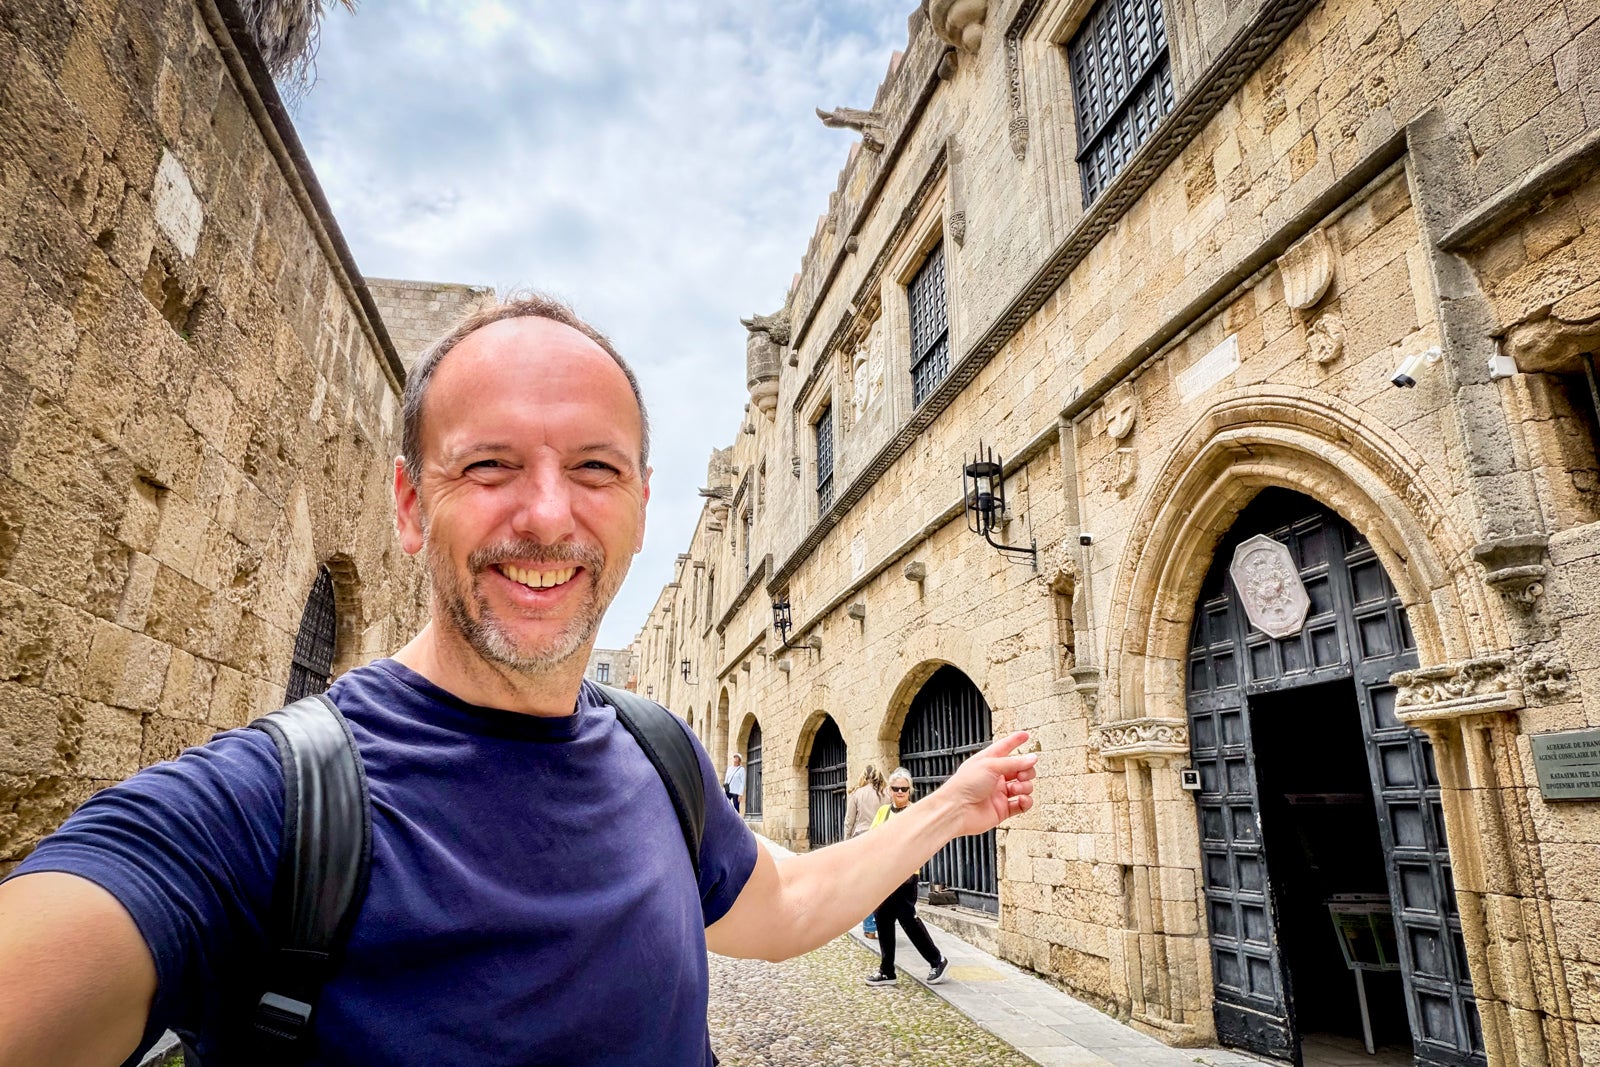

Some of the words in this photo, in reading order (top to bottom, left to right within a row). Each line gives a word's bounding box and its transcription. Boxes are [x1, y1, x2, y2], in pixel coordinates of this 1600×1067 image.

[1546, 742, 1572, 750] AUBERGE
[1558, 752, 1590, 760] CONSULAIRE
[1590, 750, 1598, 758] DE
